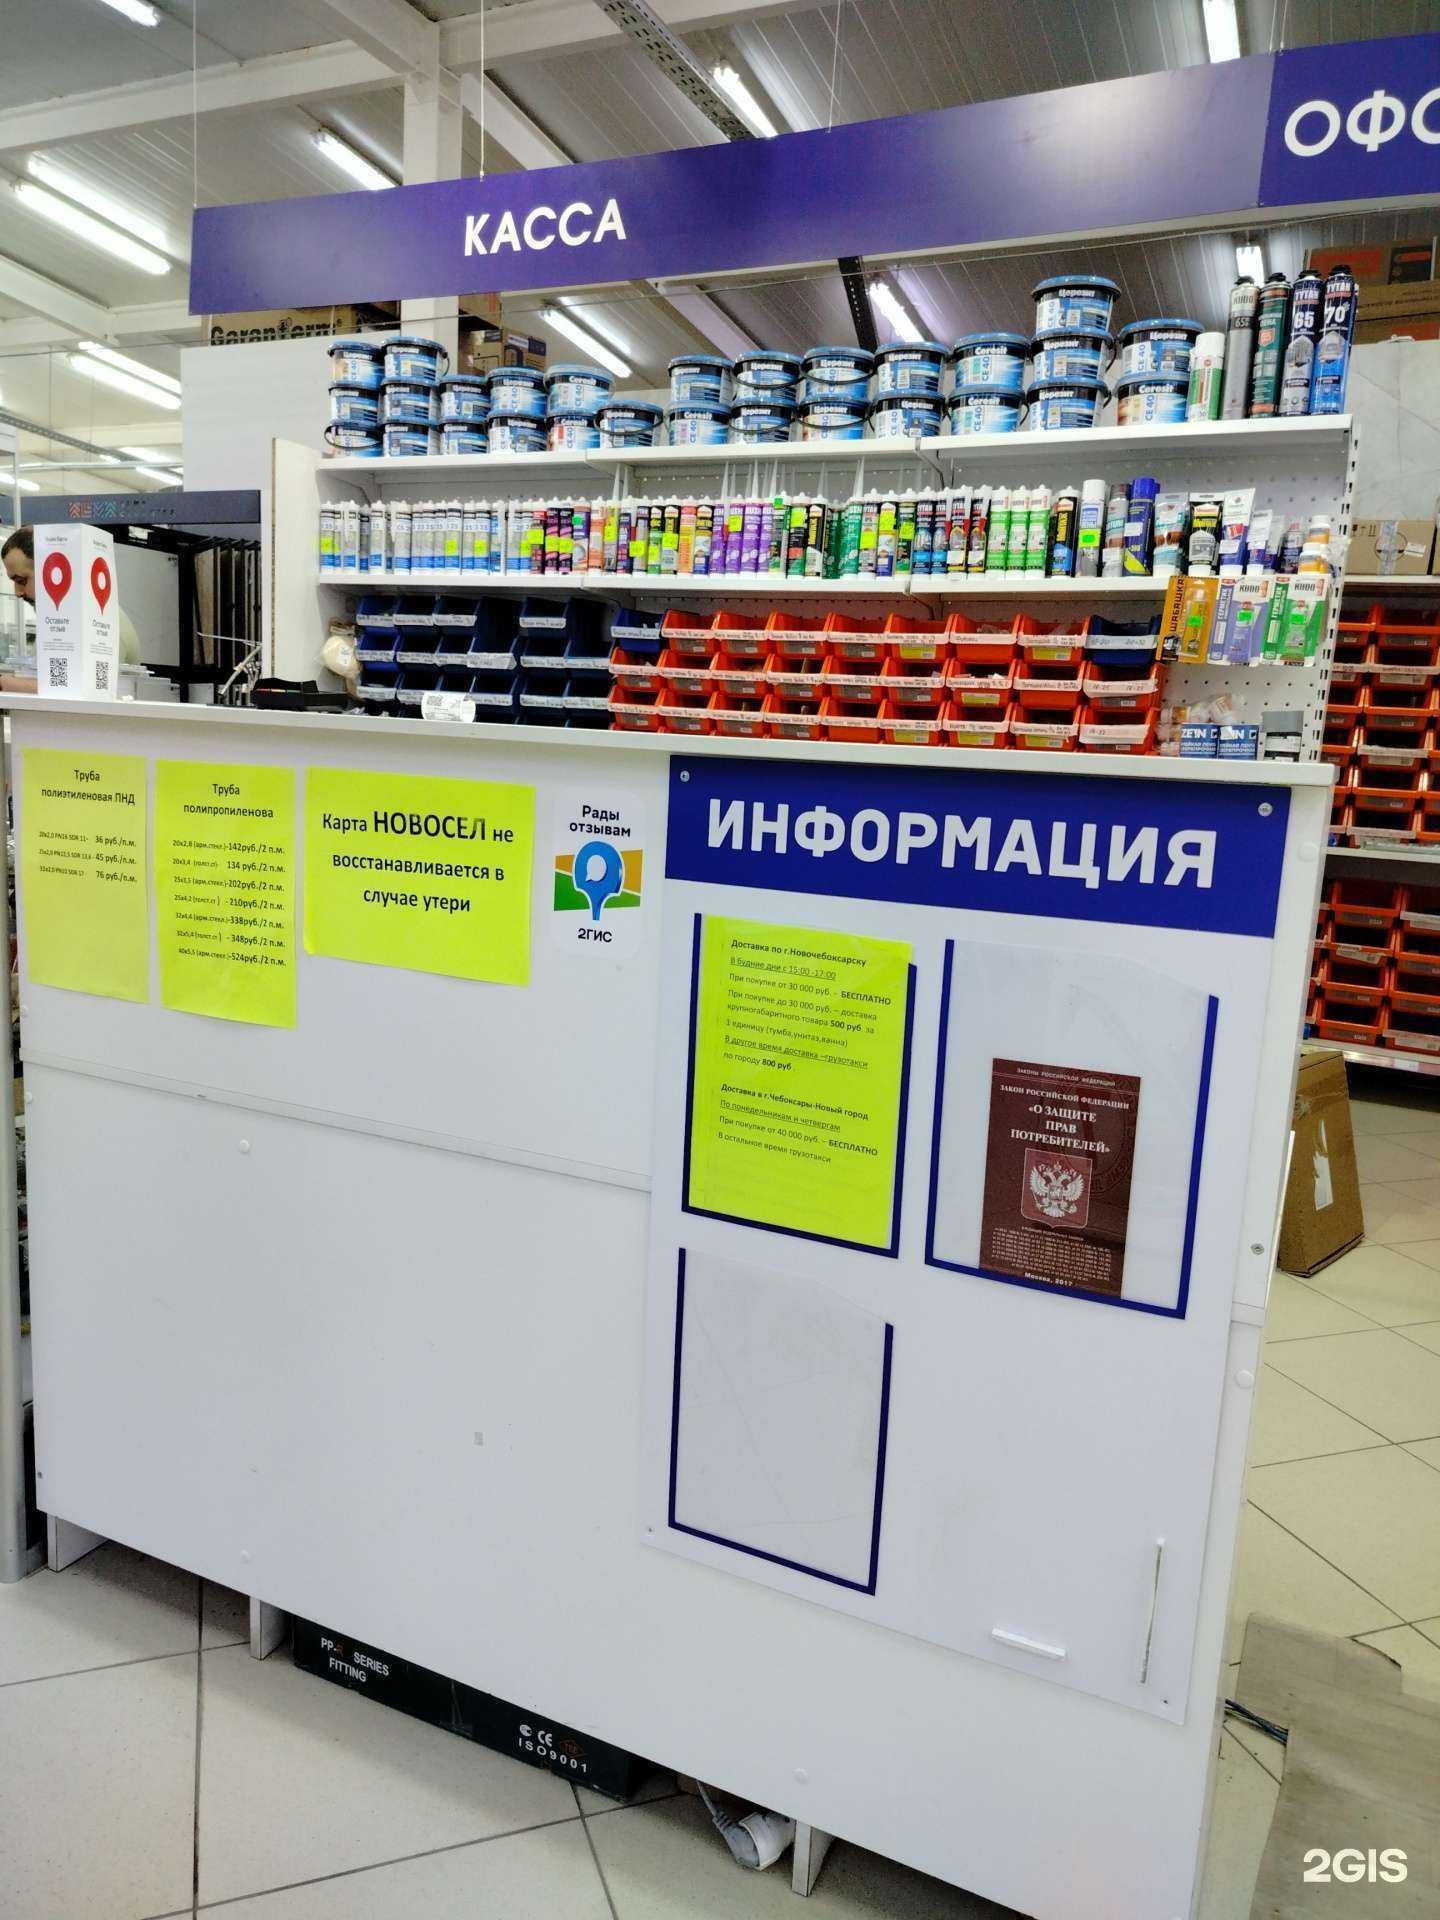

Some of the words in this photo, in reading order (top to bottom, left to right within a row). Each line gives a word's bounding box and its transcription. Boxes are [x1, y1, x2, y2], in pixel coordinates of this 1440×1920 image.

[464, 198, 627, 257] КАССА
[1294, 311, 1314, 329] 65
[74, 769, 100, 782] Труба
[41, 788, 112, 802] полиэтиленовая
[115, 792, 136, 806] ПНД
[212, 783, 240, 797] Труба
[183, 804, 274, 818] полипропиленова
[582, 804, 620, 822] Рады
[322, 813, 368, 834] Карта
[373, 810, 487, 841] НОВОСЕЛ
[492, 829, 514, 843] не
[569, 821, 631, 838] отзывам
[707, 798, 1218, 889] ИНФОРМАЦИЯ
[226, 861, 240, 869] 134
[332, 853, 489, 880] восстанавливается
[495, 867, 505, 881] в
[363, 888, 418, 907] случае
[423, 895, 471, 914] утери
[577, 927, 613, 943] 2ГИС
[731, 939, 769, 953] Доставка
[771, 945, 781, 955] по
[729, 973, 744, 984] При
[841, 990, 891, 1006] БЕСПЛАТНО
[728, 989, 743, 1000] При
[840, 1010, 877, 1021] доставка
[830, 1019, 845, 1029] 500
[761, 1058, 776, 1068] 800
[721, 1083, 756, 1098] Доставка
[844, 1110, 869, 1121] город
[1000, 1084, 1024, 1094] ЗАКОН
[1026, 1088, 1079, 1102] РОССИЙСКОЙ
[1045, 1105, 1097, 1123] ЗАЩИТЕ
[719, 1115, 734, 1126] При
[777, 1127, 787, 1136] 40
[828, 1139, 878, 1156] БЕСПЛАТНО
[1046, 1120, 1077, 1134] ПРАВ
[329, 1657, 367, 1682] FITTING
[354, 1652, 389, 1677] SERIES
